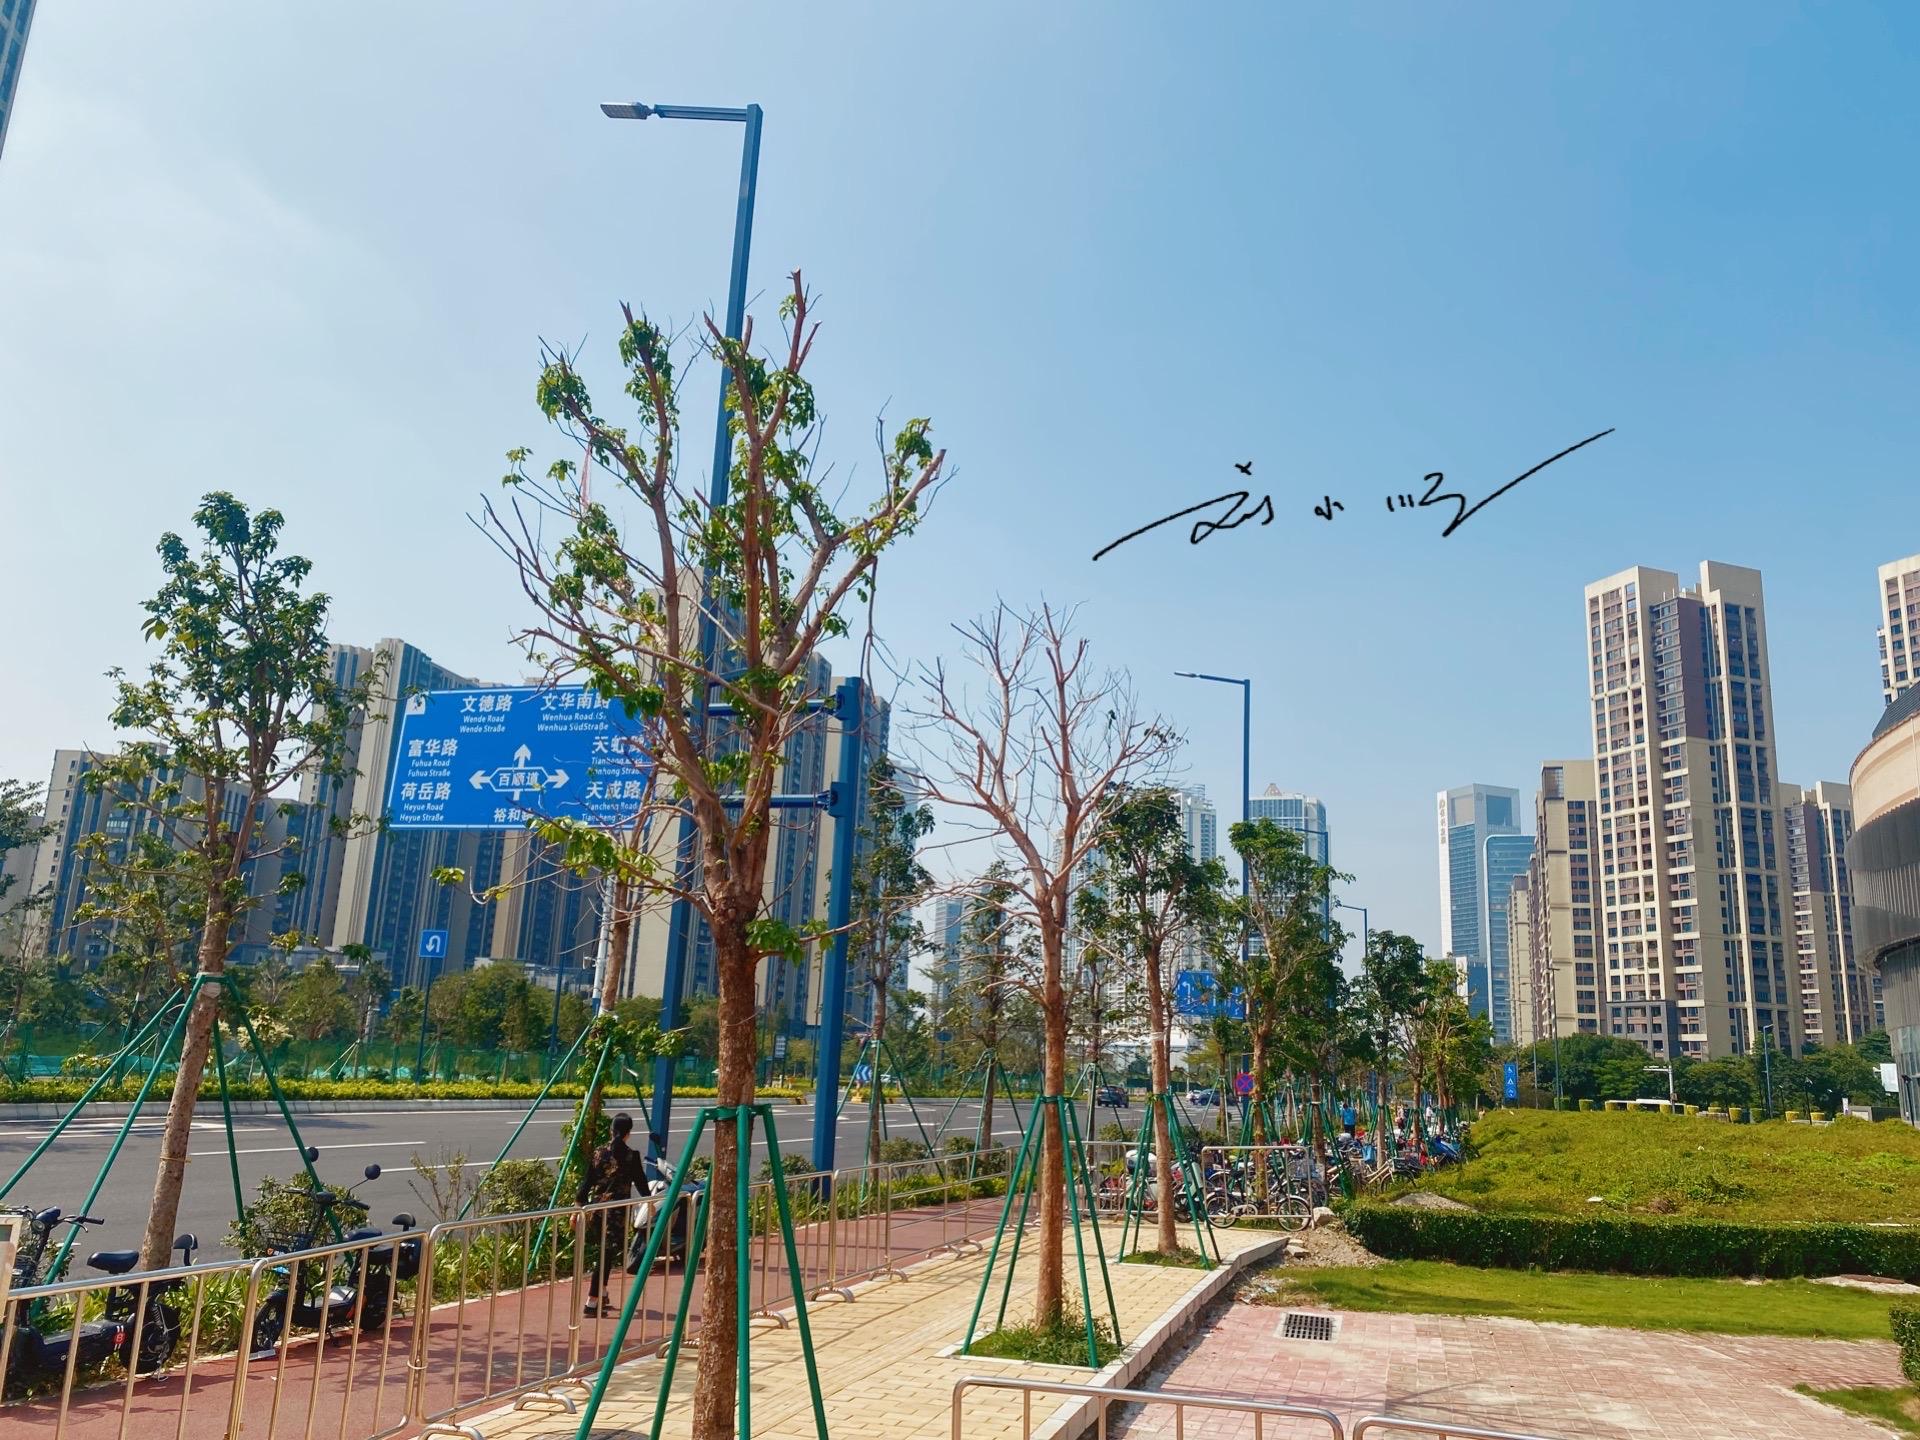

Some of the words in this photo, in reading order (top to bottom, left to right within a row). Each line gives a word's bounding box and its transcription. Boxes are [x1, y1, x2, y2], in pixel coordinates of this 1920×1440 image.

[460, 694, 513, 713] 文德路
[540, 691, 612, 711] 文华南路
[463, 715, 486, 724] Wende
[487, 714, 505, 723] Road
[542, 713, 573, 722] Wenhua
[460, 725, 483, 734] Wende
[483, 723, 506, 733] Straße
[537, 723, 568, 732] Wenhua
[408, 738, 459, 758] 富华路
[411, 759, 432, 768] Fuhua
[433, 758, 451, 767] Road
[408, 769, 428, 778] Fuhua
[429, 768, 451, 777] Straße
[498, 771, 540, 787] 百顺道
[400, 781, 452, 801] 荷岳路
[585, 780, 641, 799] 天成路
[403, 803, 425, 813] Heyue
[426, 802, 444, 811] Road
[400, 813, 422, 824] Heyue
[422, 812, 445, 822] Straße
